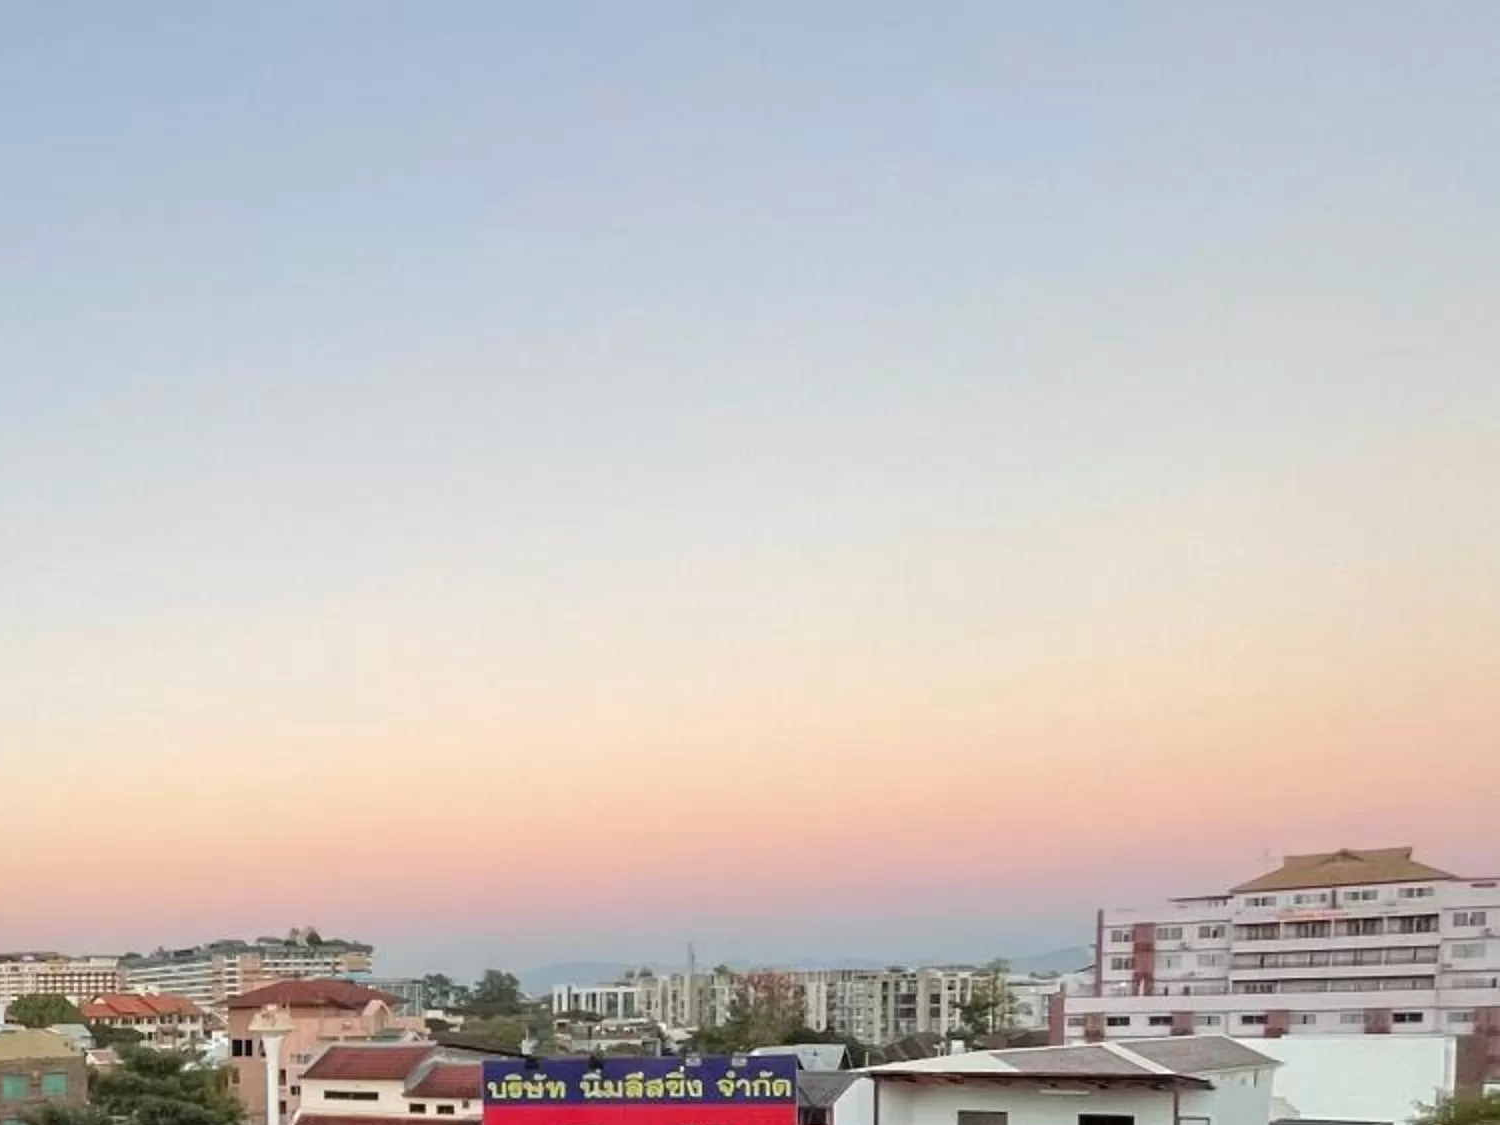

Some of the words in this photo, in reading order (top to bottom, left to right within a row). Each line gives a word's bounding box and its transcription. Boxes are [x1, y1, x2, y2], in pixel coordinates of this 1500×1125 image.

[487, 1073, 566, 1099] บริษัท
[716, 1070, 791, 1098] จำกัด
